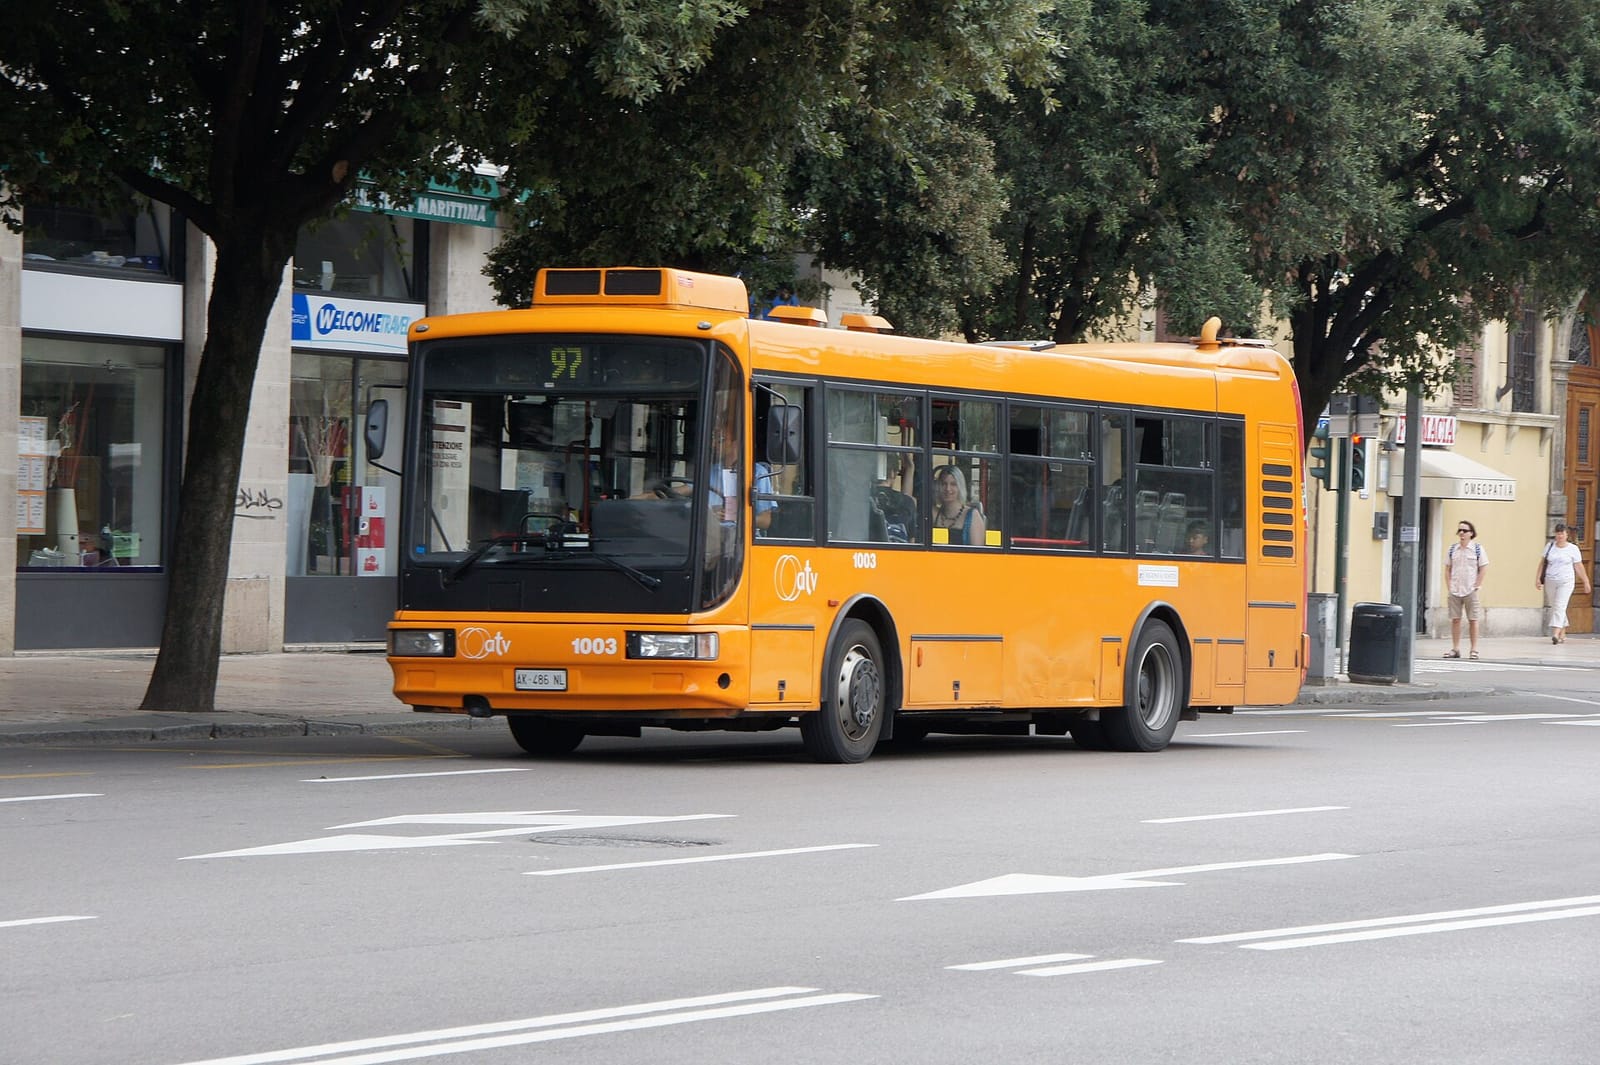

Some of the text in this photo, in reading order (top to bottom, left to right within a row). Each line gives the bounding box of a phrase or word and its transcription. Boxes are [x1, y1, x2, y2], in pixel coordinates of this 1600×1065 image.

[417, 197, 487, 222] MARITTIMA
[551, 347, 582, 379] 97
[1464, 482, 1513, 497] OMEOPATIA
[852, 552, 877, 569] 1003
[571, 637, 618, 655] 1003
[553, 674, 565, 686] NL
